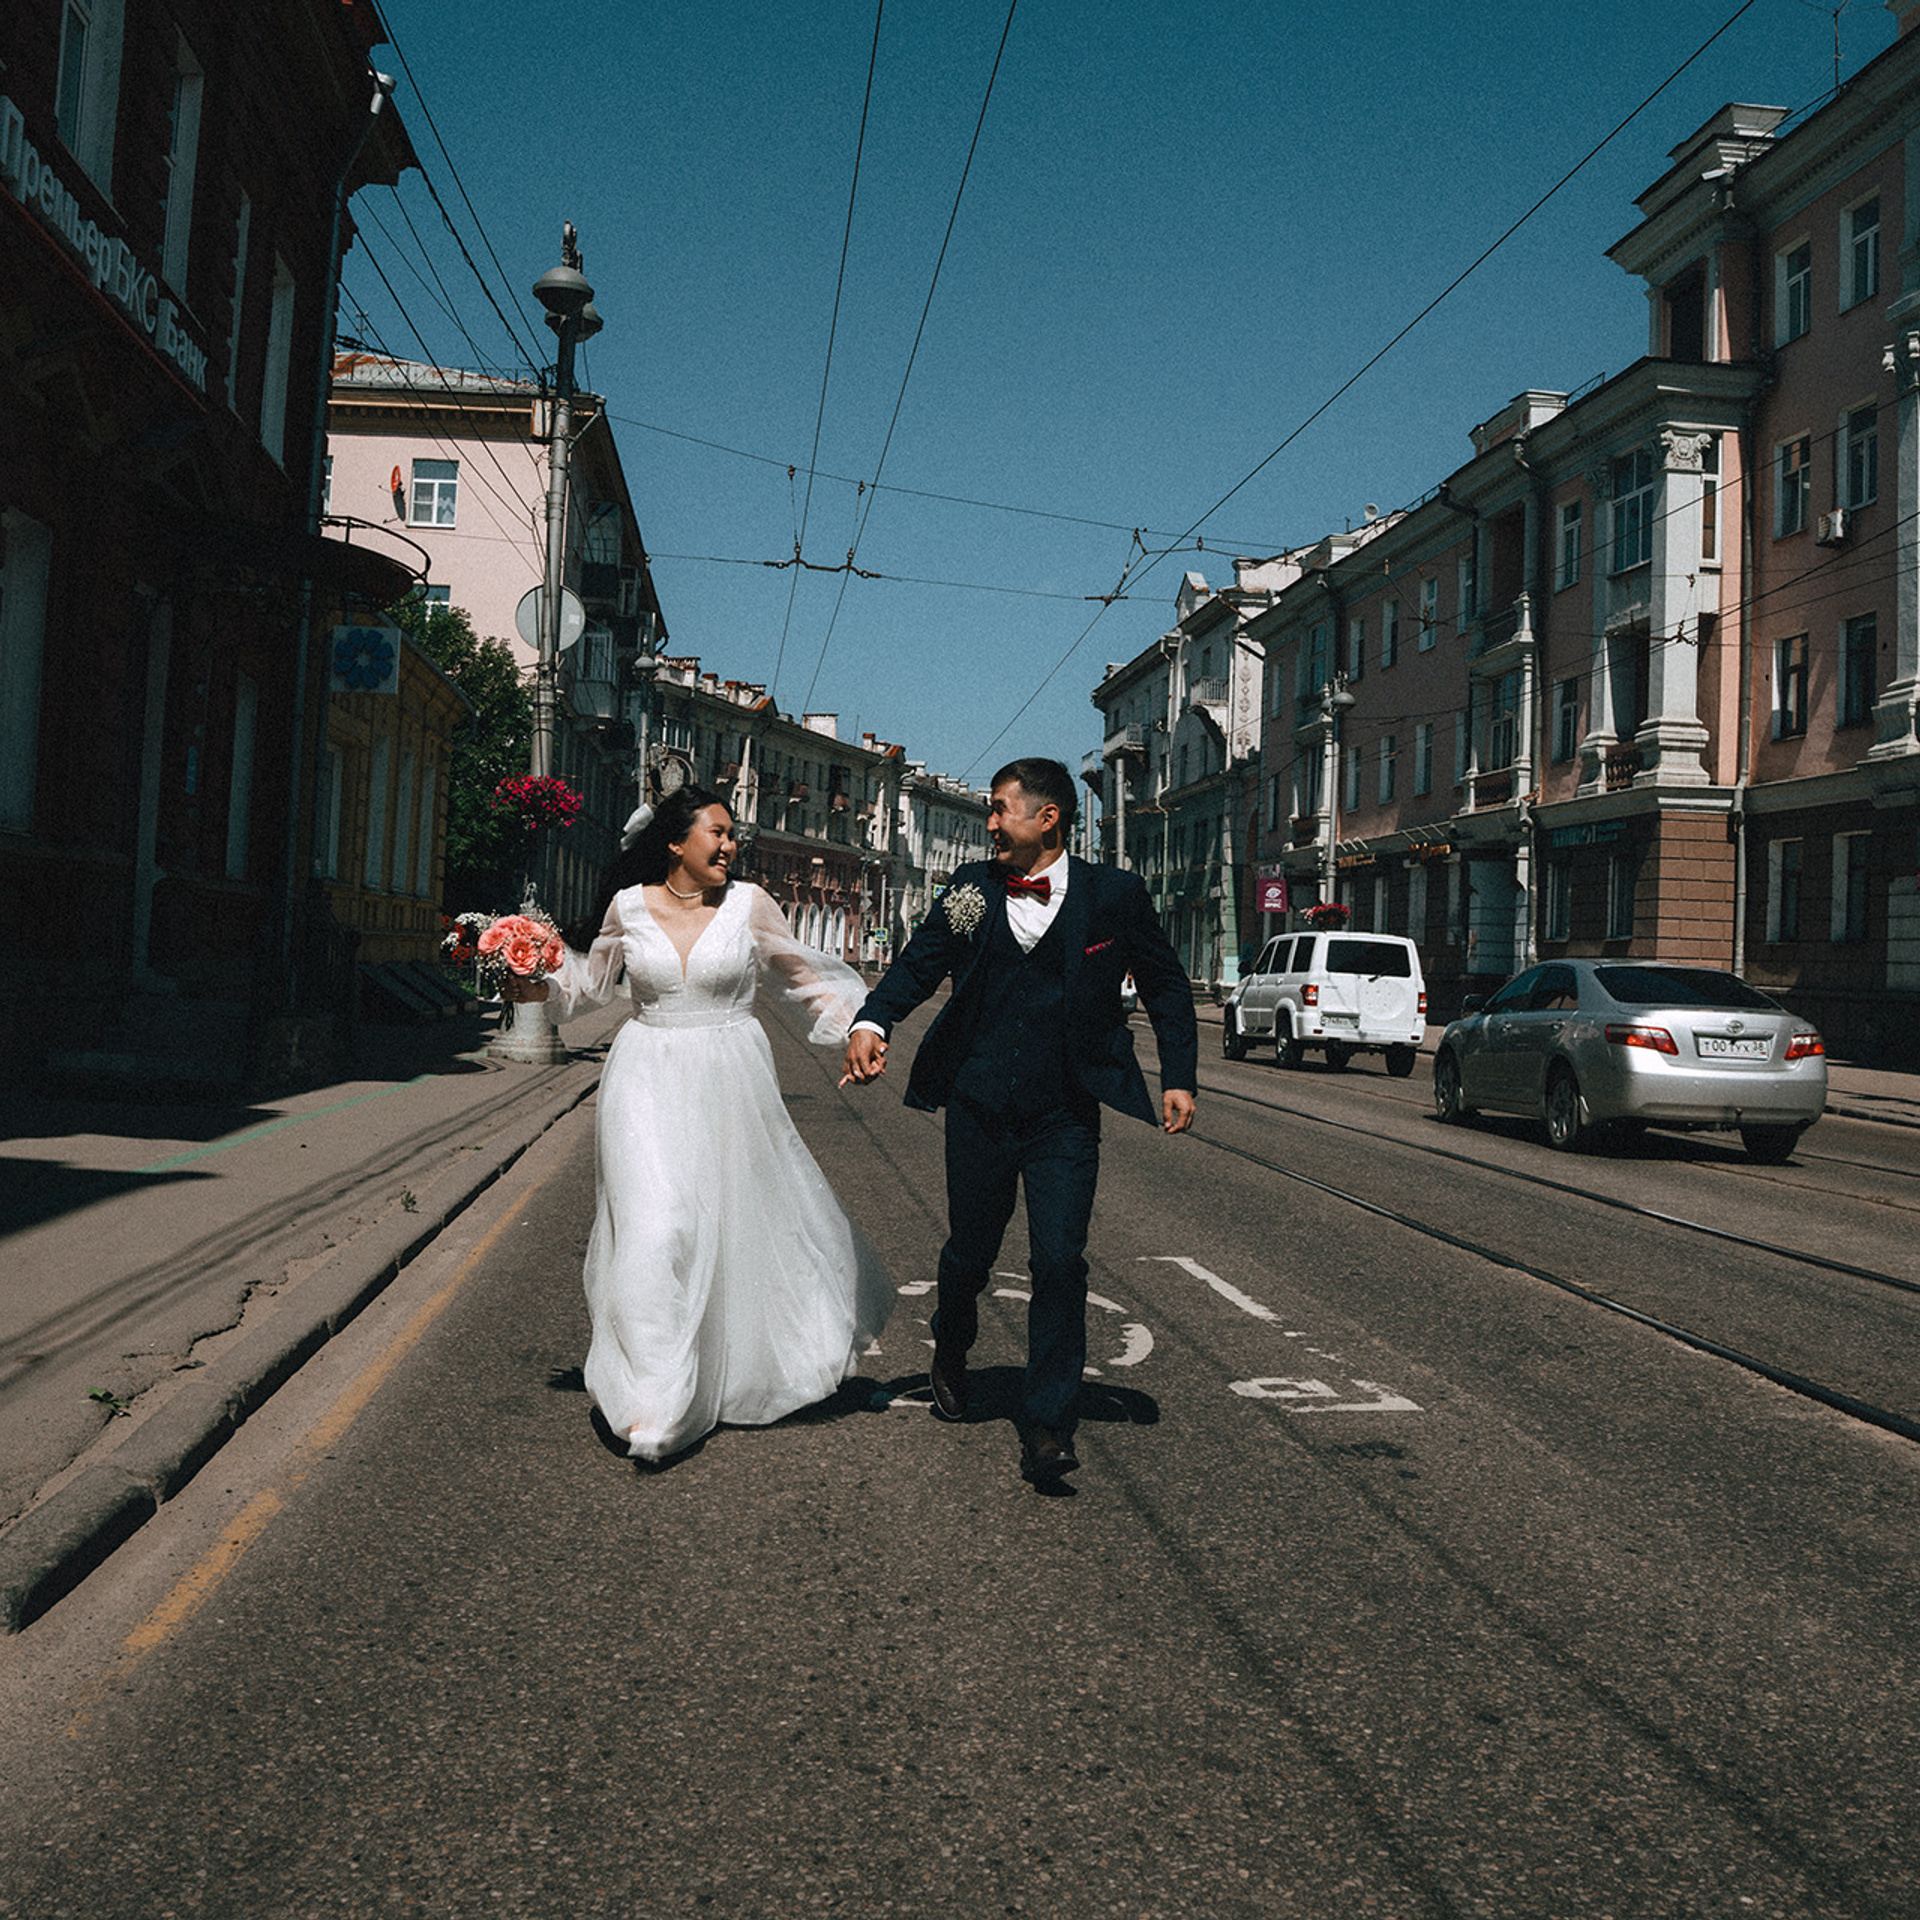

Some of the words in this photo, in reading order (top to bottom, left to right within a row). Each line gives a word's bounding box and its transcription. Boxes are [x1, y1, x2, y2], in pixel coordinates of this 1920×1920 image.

[0, 94, 112, 290] Премьер
[107, 236, 159, 335] БКС
[156, 297, 209, 393] Банк
